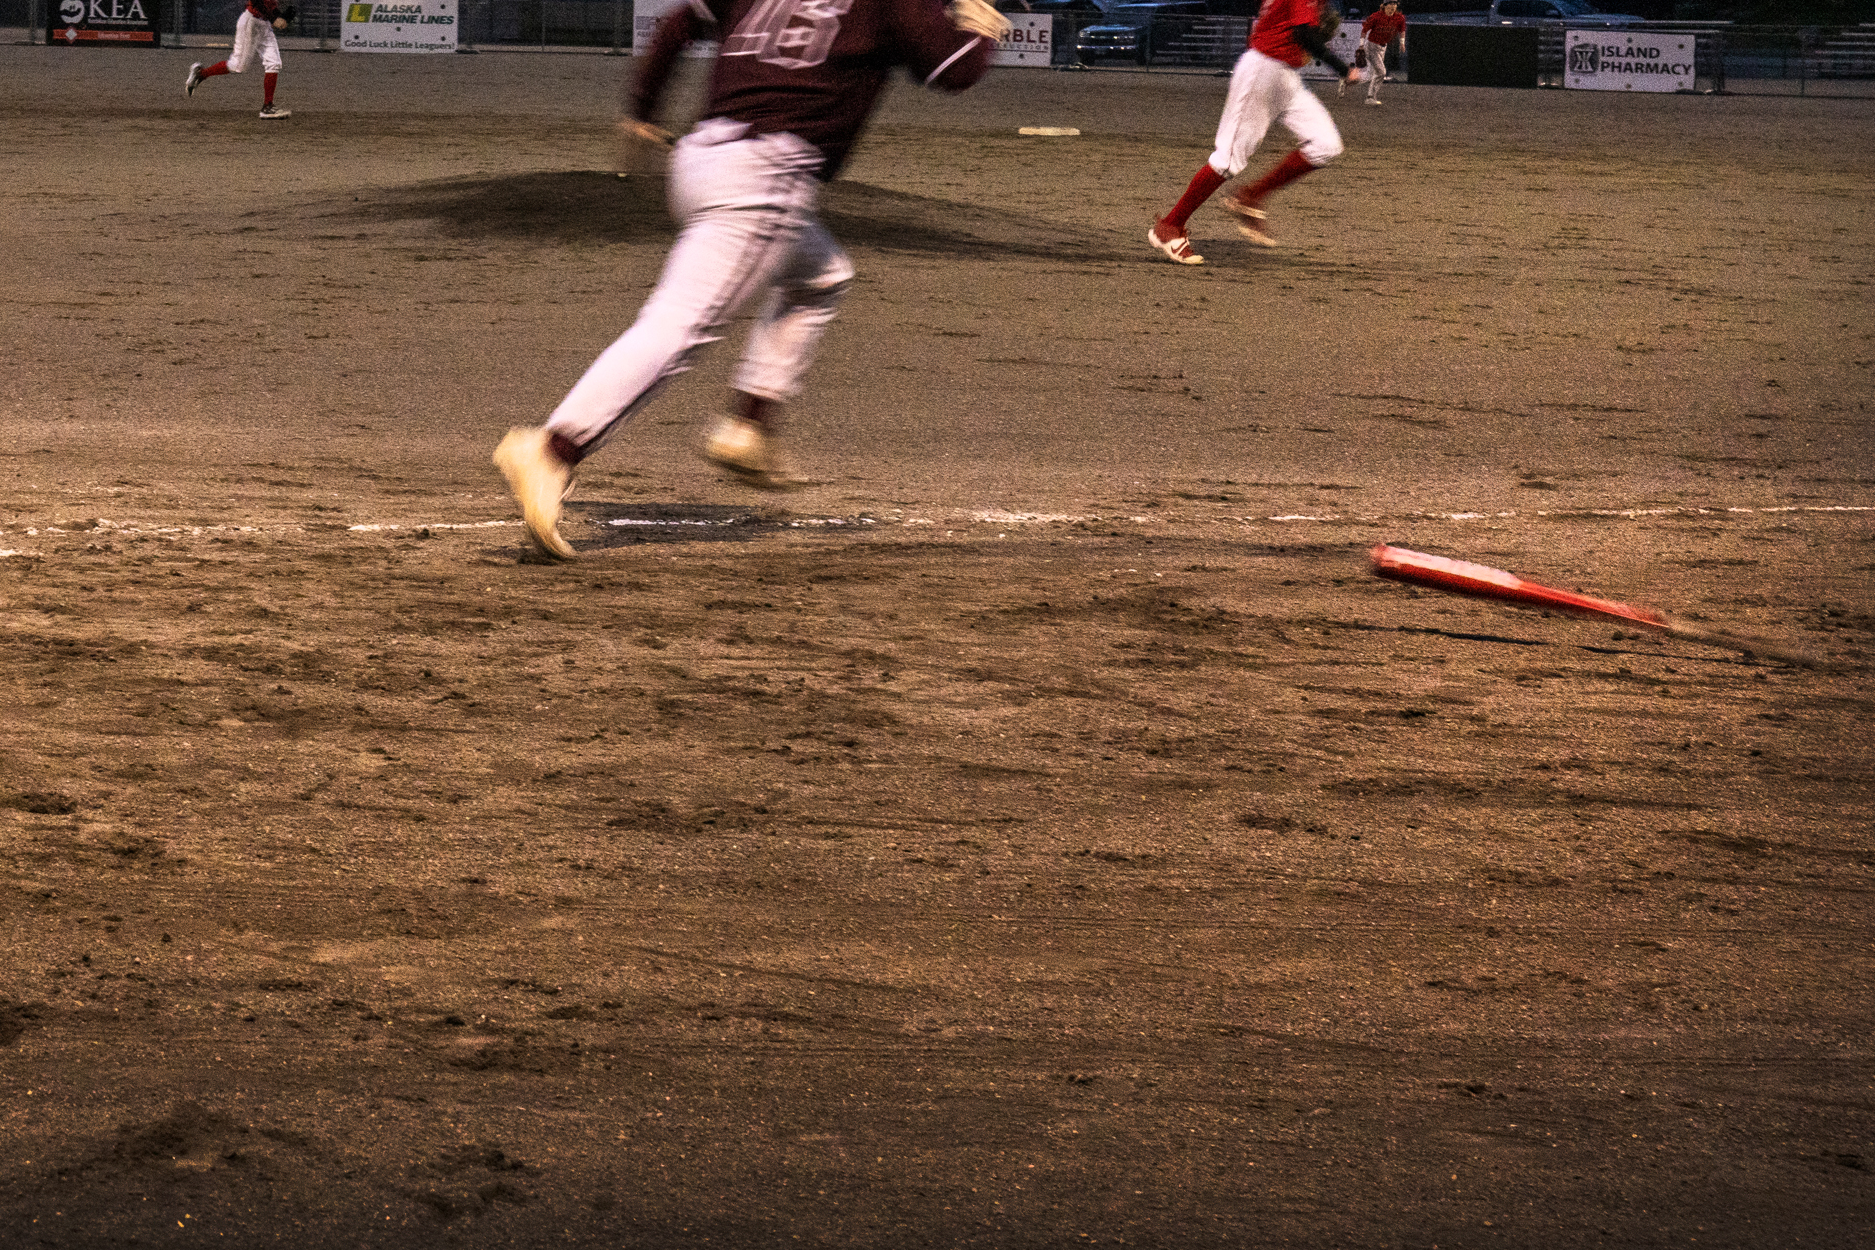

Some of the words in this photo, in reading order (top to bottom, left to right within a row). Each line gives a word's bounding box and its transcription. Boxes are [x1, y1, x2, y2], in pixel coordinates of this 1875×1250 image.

[374, 4, 422, 14] ALASKA
[371, 14, 418, 24] MARINE
[419, 15, 455, 25] LINES
[999, 29, 1049, 44] RBLE
[345, 40, 367, 48] Good
[369, 40, 388, 49] Luck
[390, 41, 413, 49] Little
[415, 41, 455, 51] Leaguers!
[1601, 46, 1660, 59] ISLAND
[1600, 62, 1692, 75] PHARMACY
